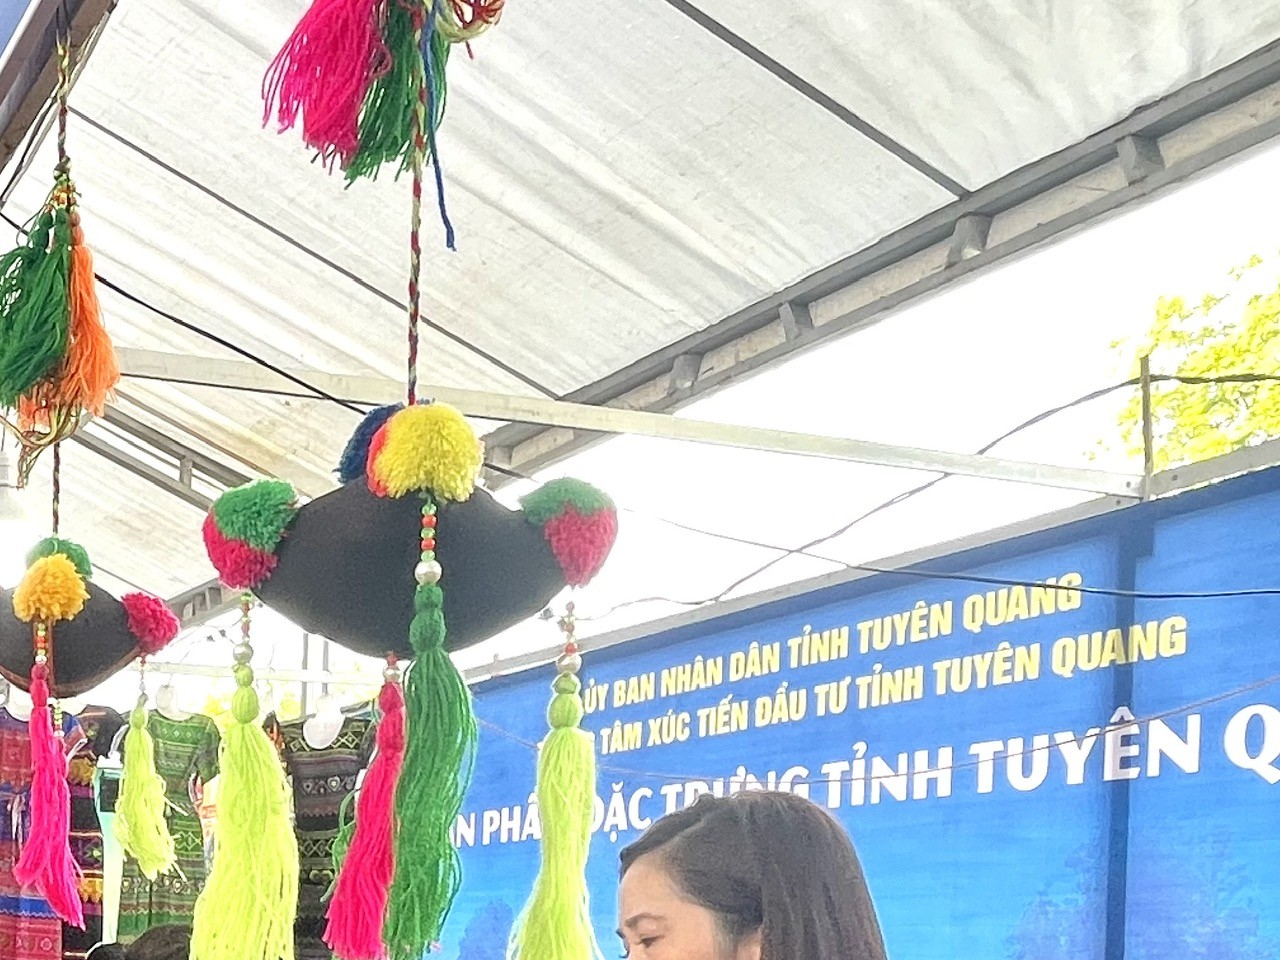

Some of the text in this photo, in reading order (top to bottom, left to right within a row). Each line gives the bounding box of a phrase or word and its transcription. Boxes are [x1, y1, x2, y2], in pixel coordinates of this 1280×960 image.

[584, 572, 1084, 714] ỦY BAN NHÂN DÂN TỈNH TUYÊN QUANG
[600, 719, 643, 755] TÂM
[646, 707, 690, 747] XÚC
[696, 693, 749, 738] TIẾN
[814, 675, 851, 716] TƯ
[855, 662, 925, 709] TỈNH
[933, 641, 1040, 696] TUYÊN
[1051, 615, 1188, 679] QUANG
[821, 741, 953, 810] TỈNH
[969, 706, 1202, 797] TUYÊN
